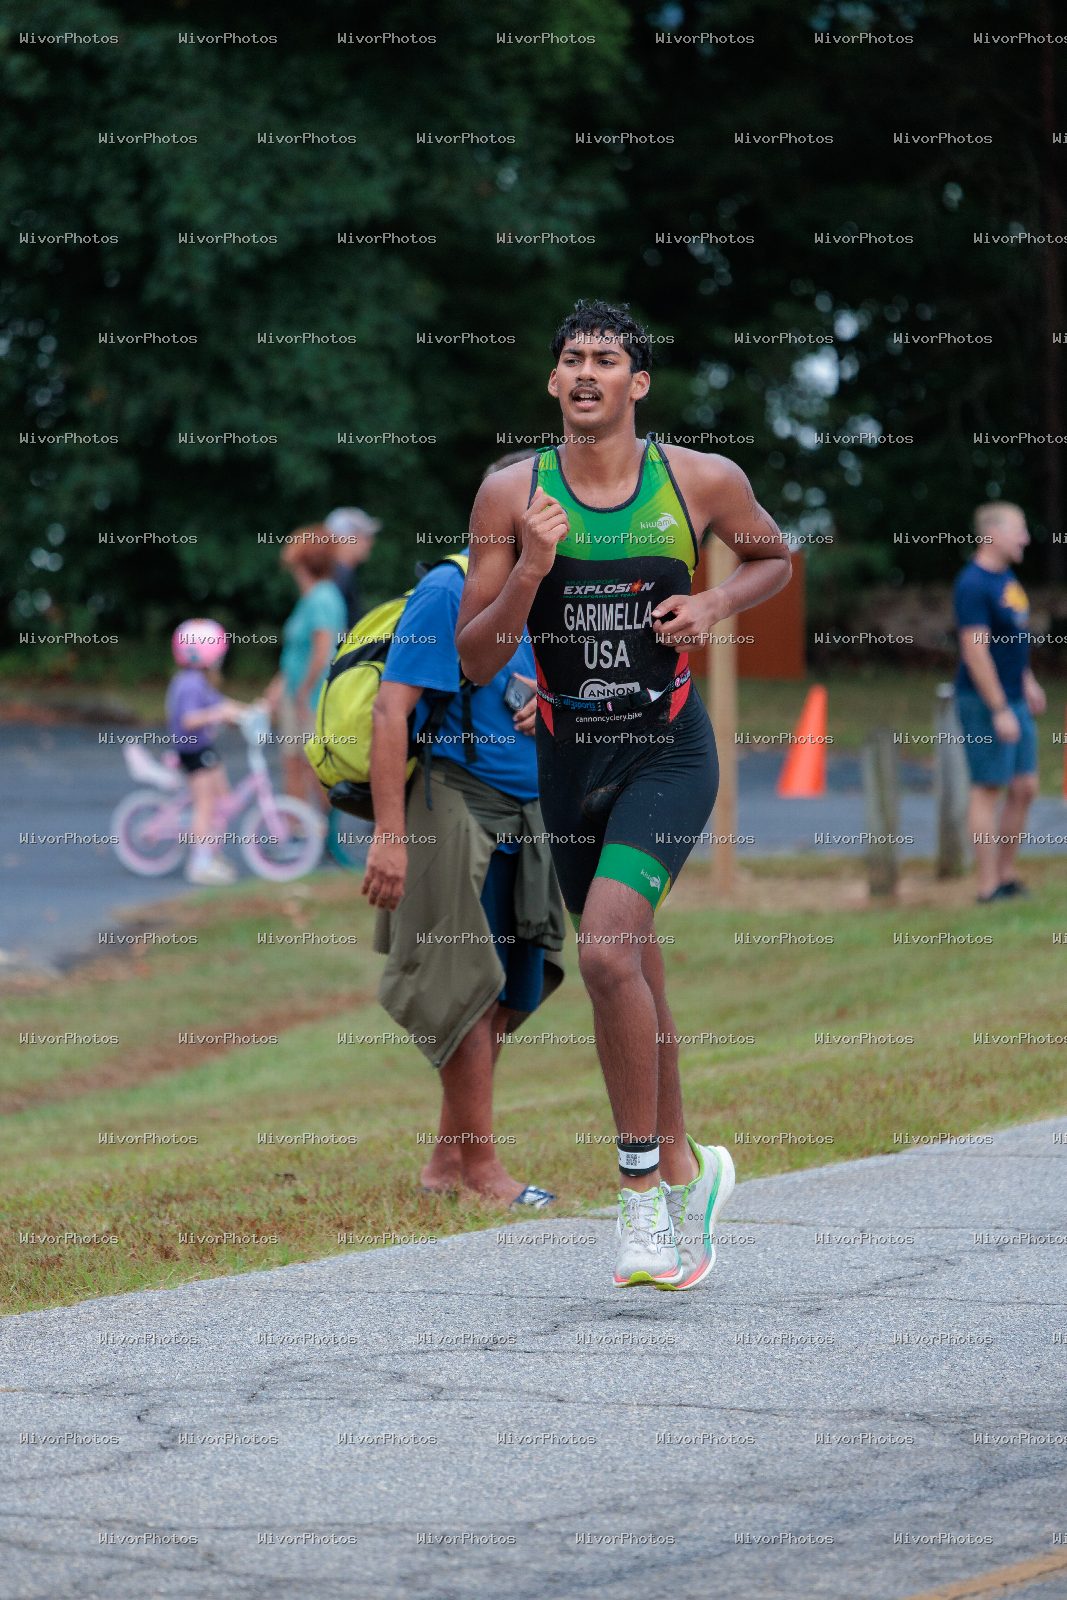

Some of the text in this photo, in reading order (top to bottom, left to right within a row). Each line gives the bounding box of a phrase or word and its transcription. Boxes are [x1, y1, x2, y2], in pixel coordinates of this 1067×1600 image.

[640, 518, 672, 529] kiwami
[564, 601, 653, 632] GARIMELLA
[584, 639, 631, 670] USA
[575, 711, 643, 723] cannoncyclery.bike
